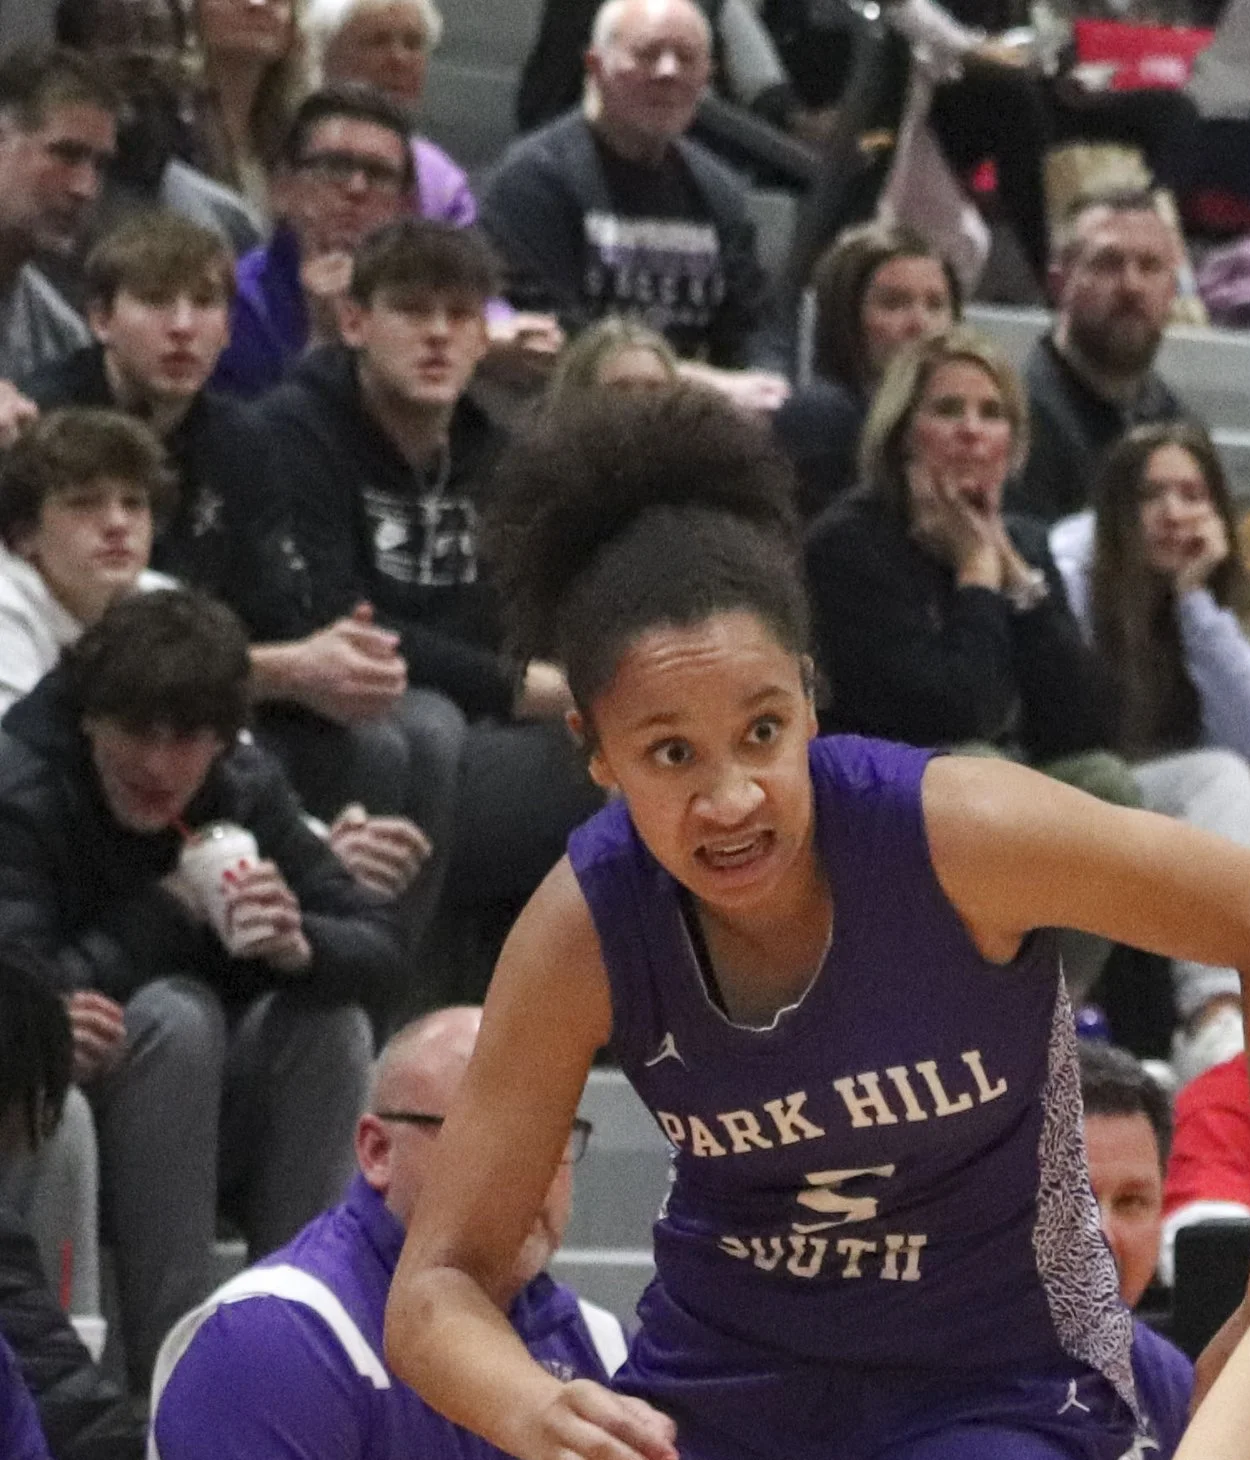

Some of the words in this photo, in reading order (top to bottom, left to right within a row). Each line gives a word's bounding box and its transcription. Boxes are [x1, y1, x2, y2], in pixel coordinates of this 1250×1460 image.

[656, 1090, 826, 1157] PARK
[832, 1050, 1008, 1128] HILL
[791, 1163, 896, 1235] 5
